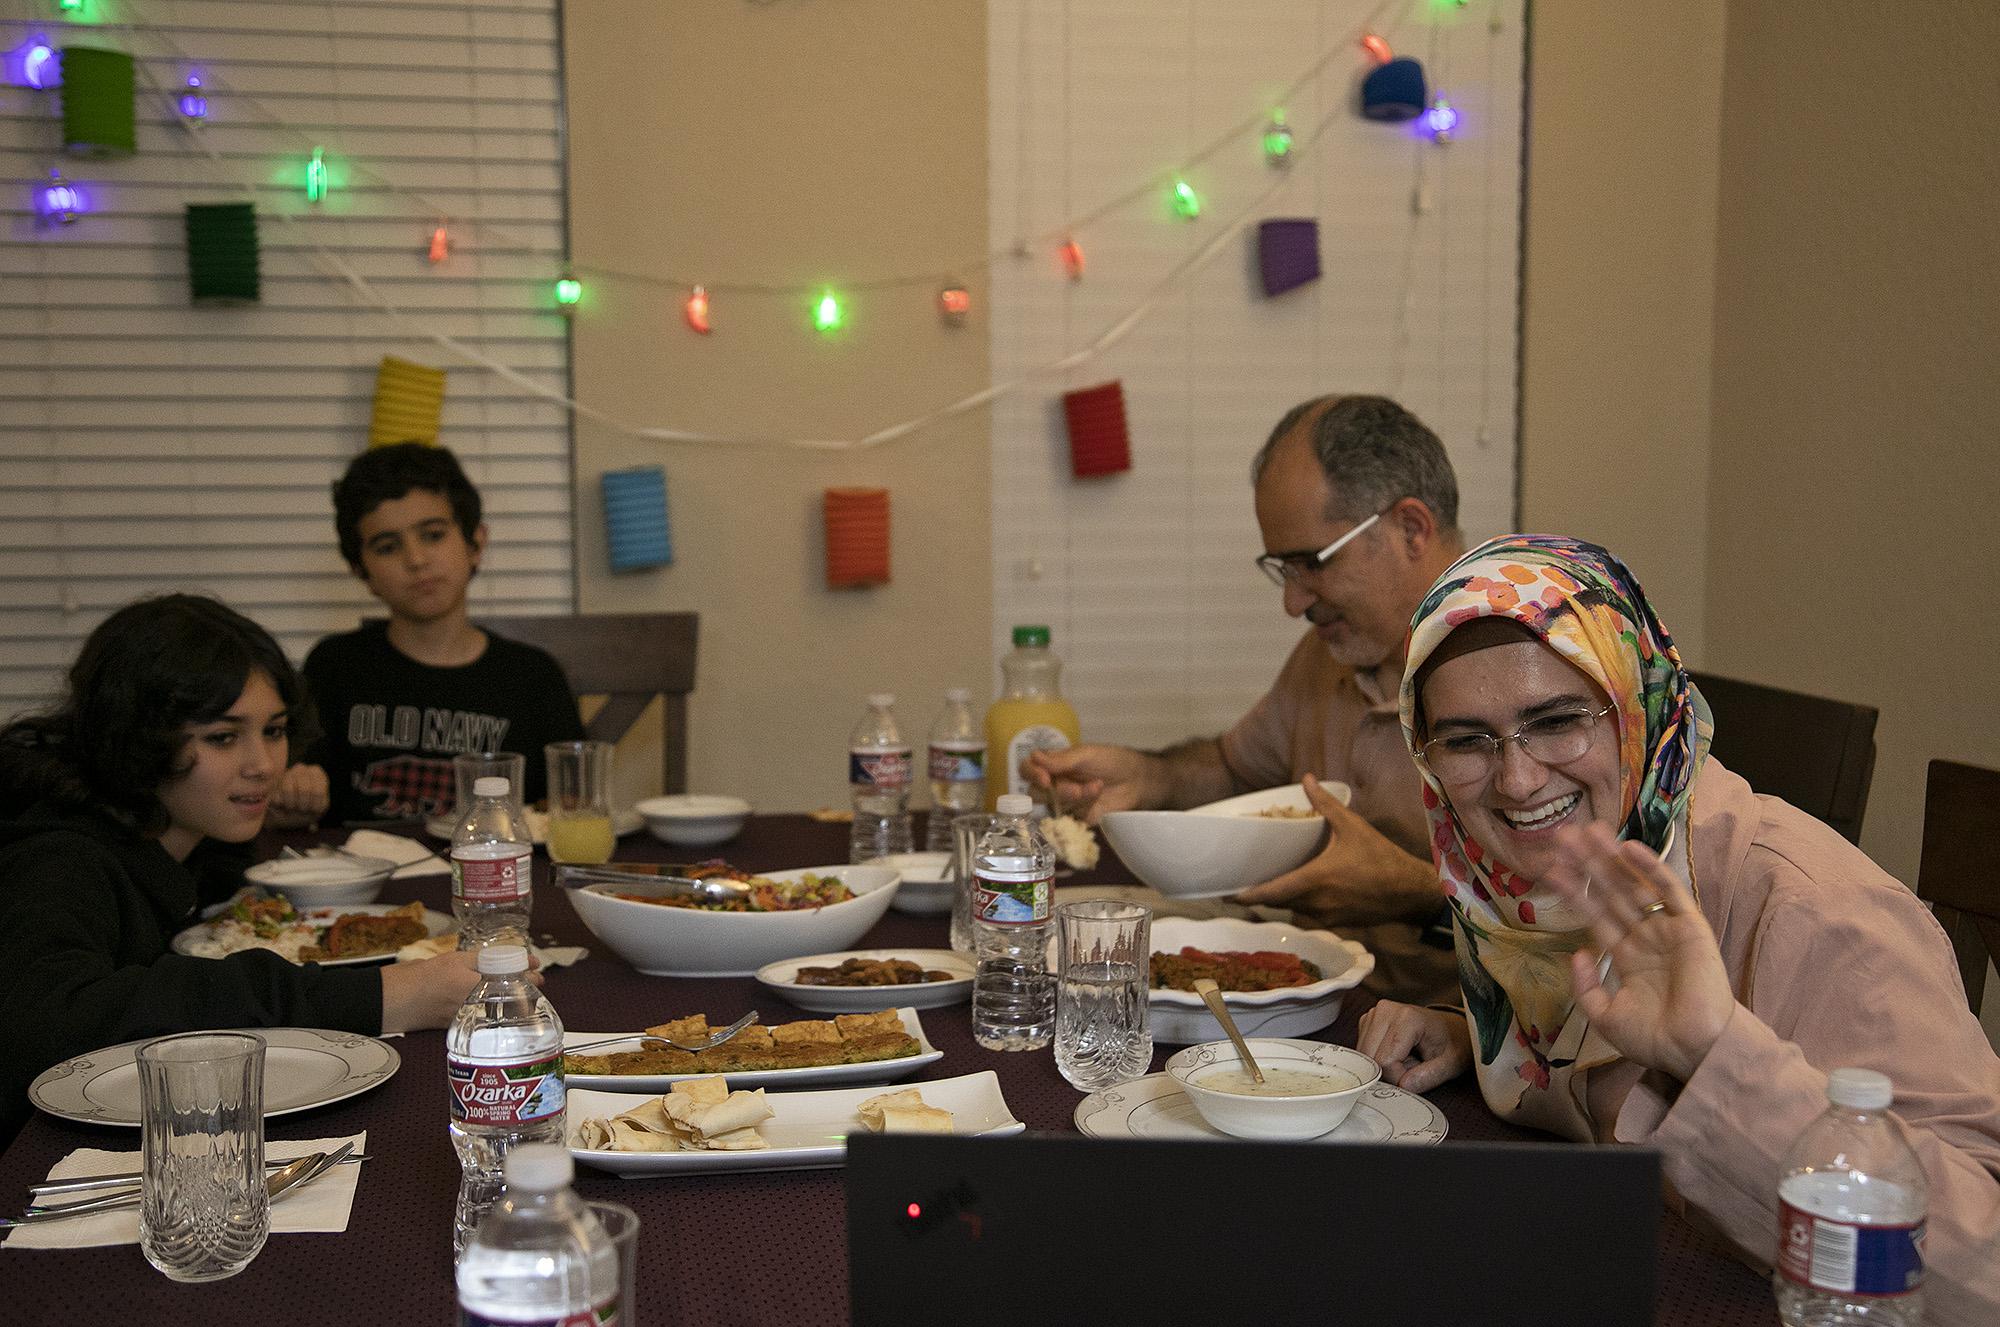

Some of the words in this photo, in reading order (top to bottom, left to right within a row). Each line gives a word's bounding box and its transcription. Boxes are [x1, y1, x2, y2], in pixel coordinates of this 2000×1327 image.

[349, 704, 421, 748] OLD
[421, 707, 511, 753] NAVY
[480, 1078, 499, 1086] 1905
[461, 1083, 527, 1104] Ozarka
[469, 1106, 489, 1119] 100%
